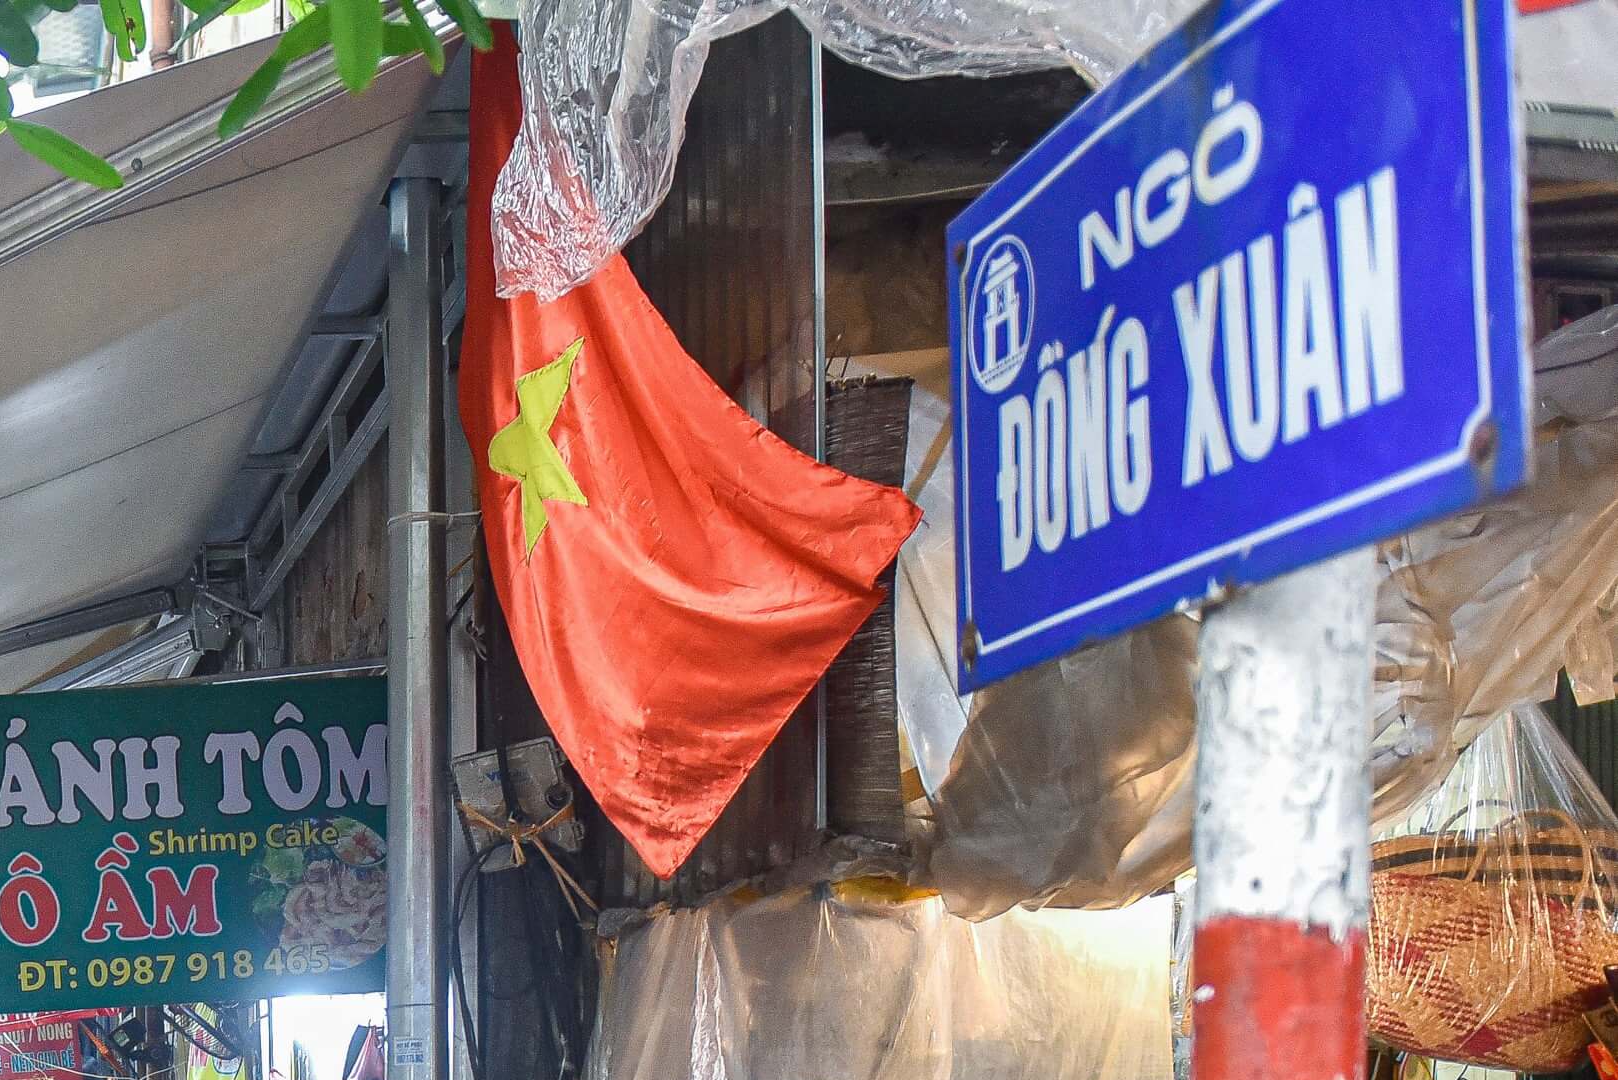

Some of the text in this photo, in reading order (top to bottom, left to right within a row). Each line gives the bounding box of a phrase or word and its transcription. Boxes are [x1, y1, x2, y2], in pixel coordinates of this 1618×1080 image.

[1080, 81, 1262, 290] NGÕ
[1172, 166, 1404, 487] XUÂN
[203, 701, 388, 815] TÔM
[82, 831, 223, 942] ẦM
[148, 821, 339, 857] Shrimp Cake
[18, 943, 331, 993] ĐT: 0987 918 465
